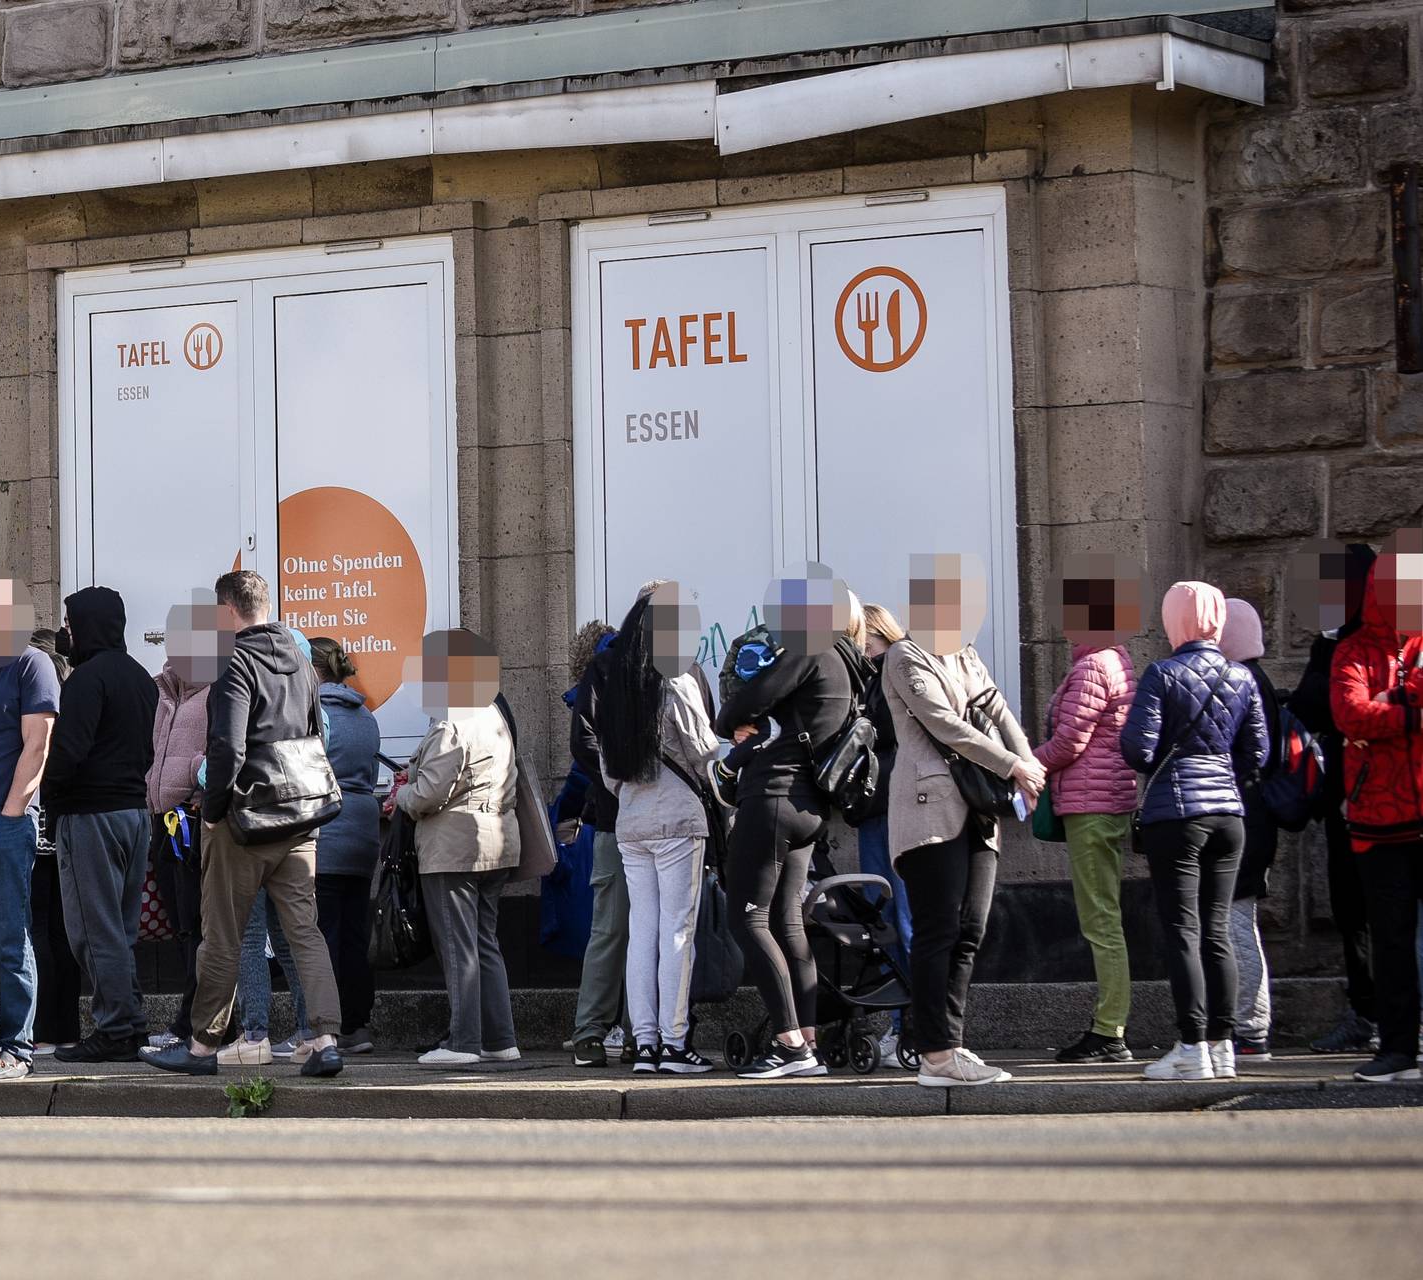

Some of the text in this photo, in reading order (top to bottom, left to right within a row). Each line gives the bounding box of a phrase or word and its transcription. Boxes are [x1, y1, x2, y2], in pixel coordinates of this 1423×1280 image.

[625, 312, 748, 370] TAFEL
[118, 341, 170, 368] TAFEL
[118, 386, 150, 401] ESSEN
[626, 410, 699, 443] ESSEN
[283, 552, 403, 575] Ohne Spenden
[284, 580, 377, 601] keine Tafel.
[285, 608, 368, 629] Helfen Sie
[342, 636, 396, 654] helfen.
